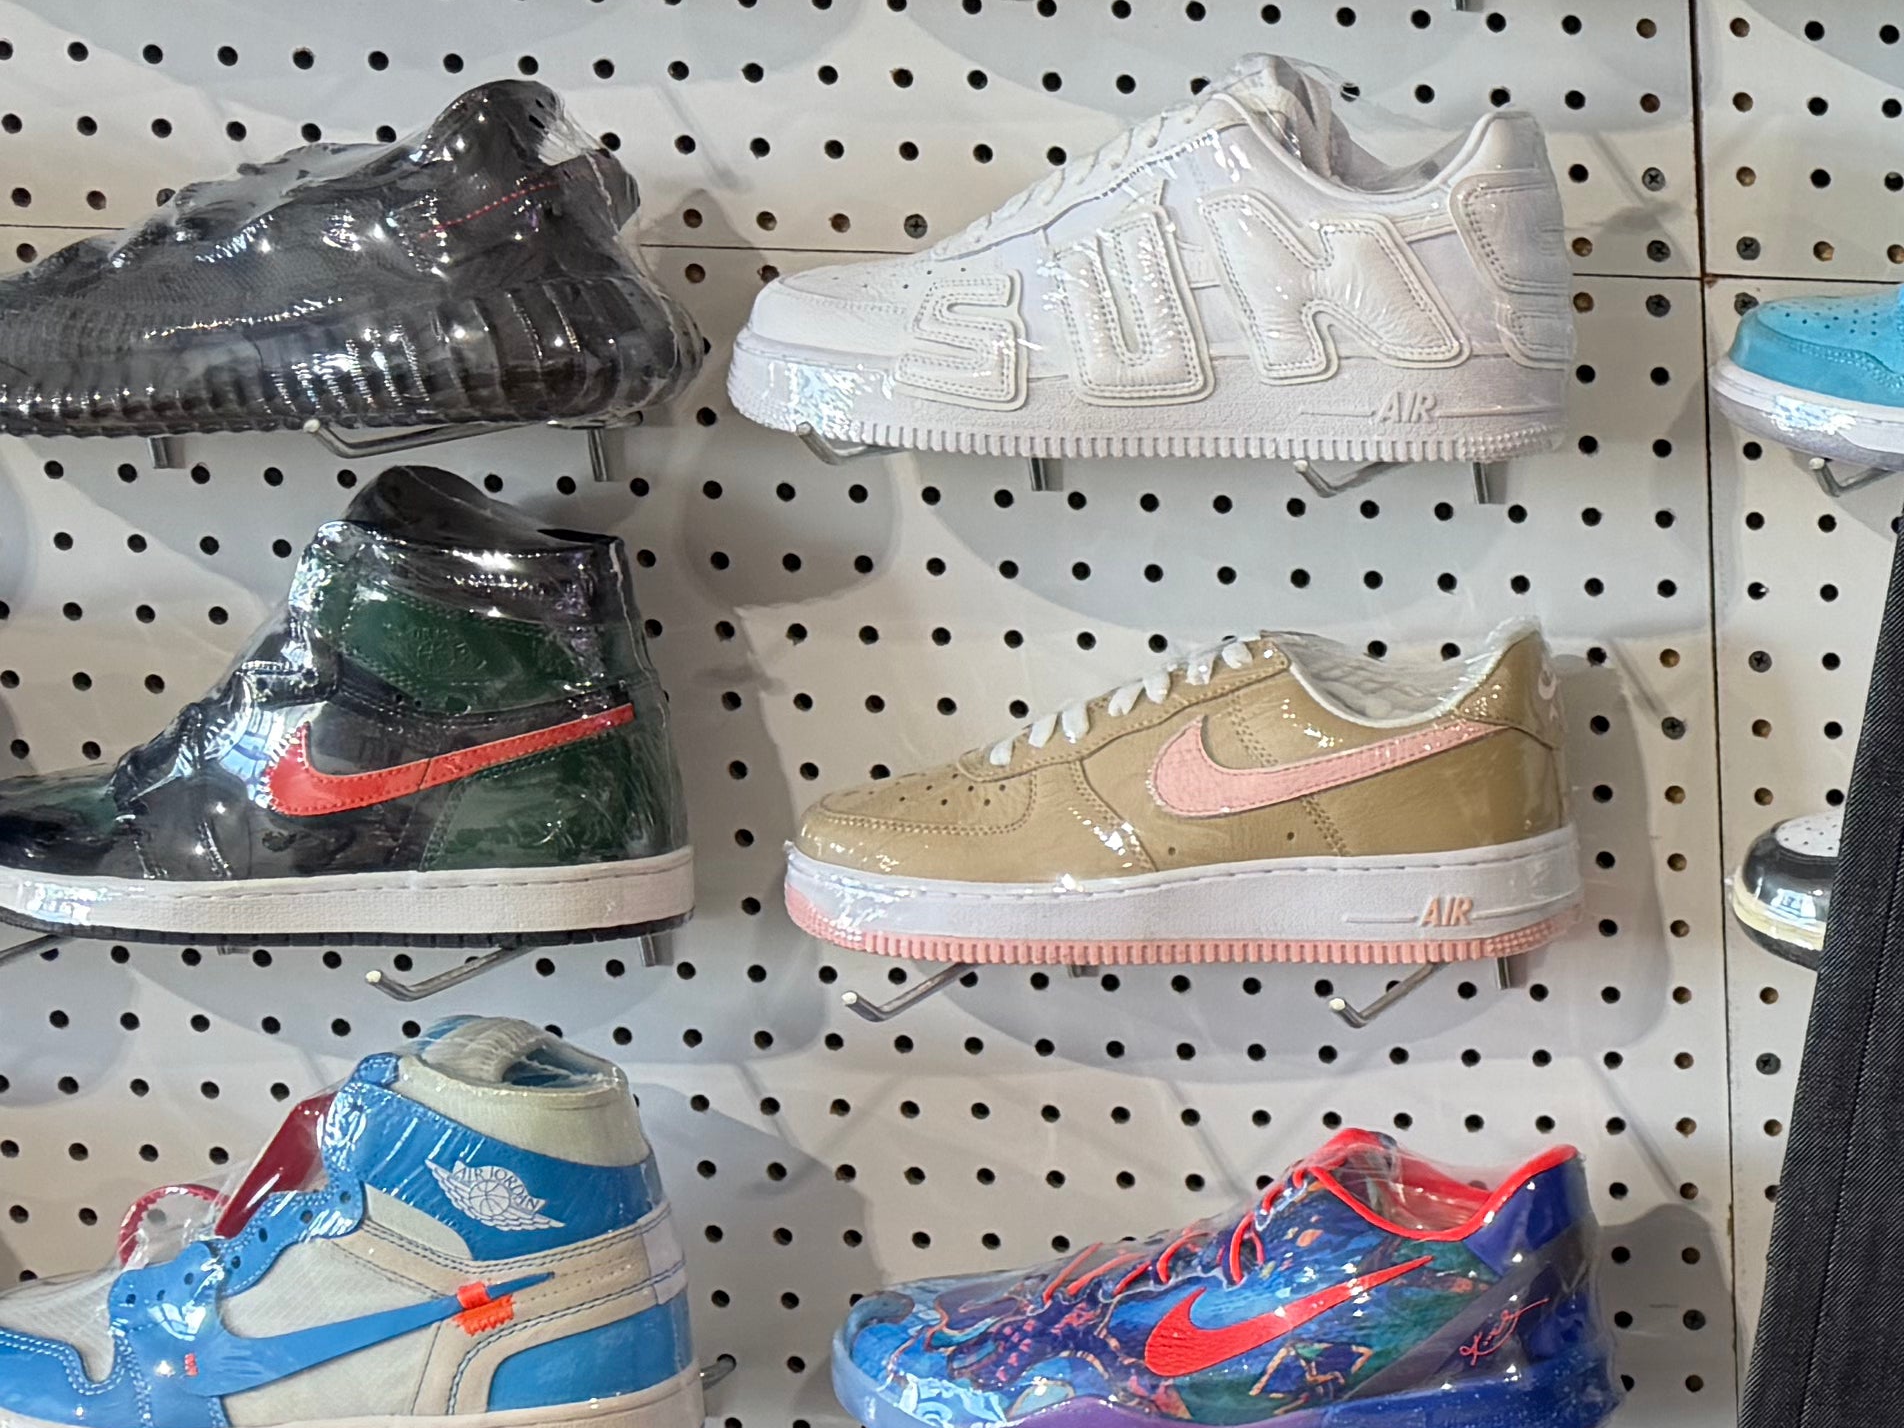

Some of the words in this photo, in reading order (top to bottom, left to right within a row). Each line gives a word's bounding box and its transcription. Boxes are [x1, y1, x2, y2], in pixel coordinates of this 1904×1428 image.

[1374, 389, 1437, 425] AIR
[1416, 894, 1474, 928] AIR
[454, 1166, 485, 1183] AIR
[488, 1166, 541, 1212] JORDAN
